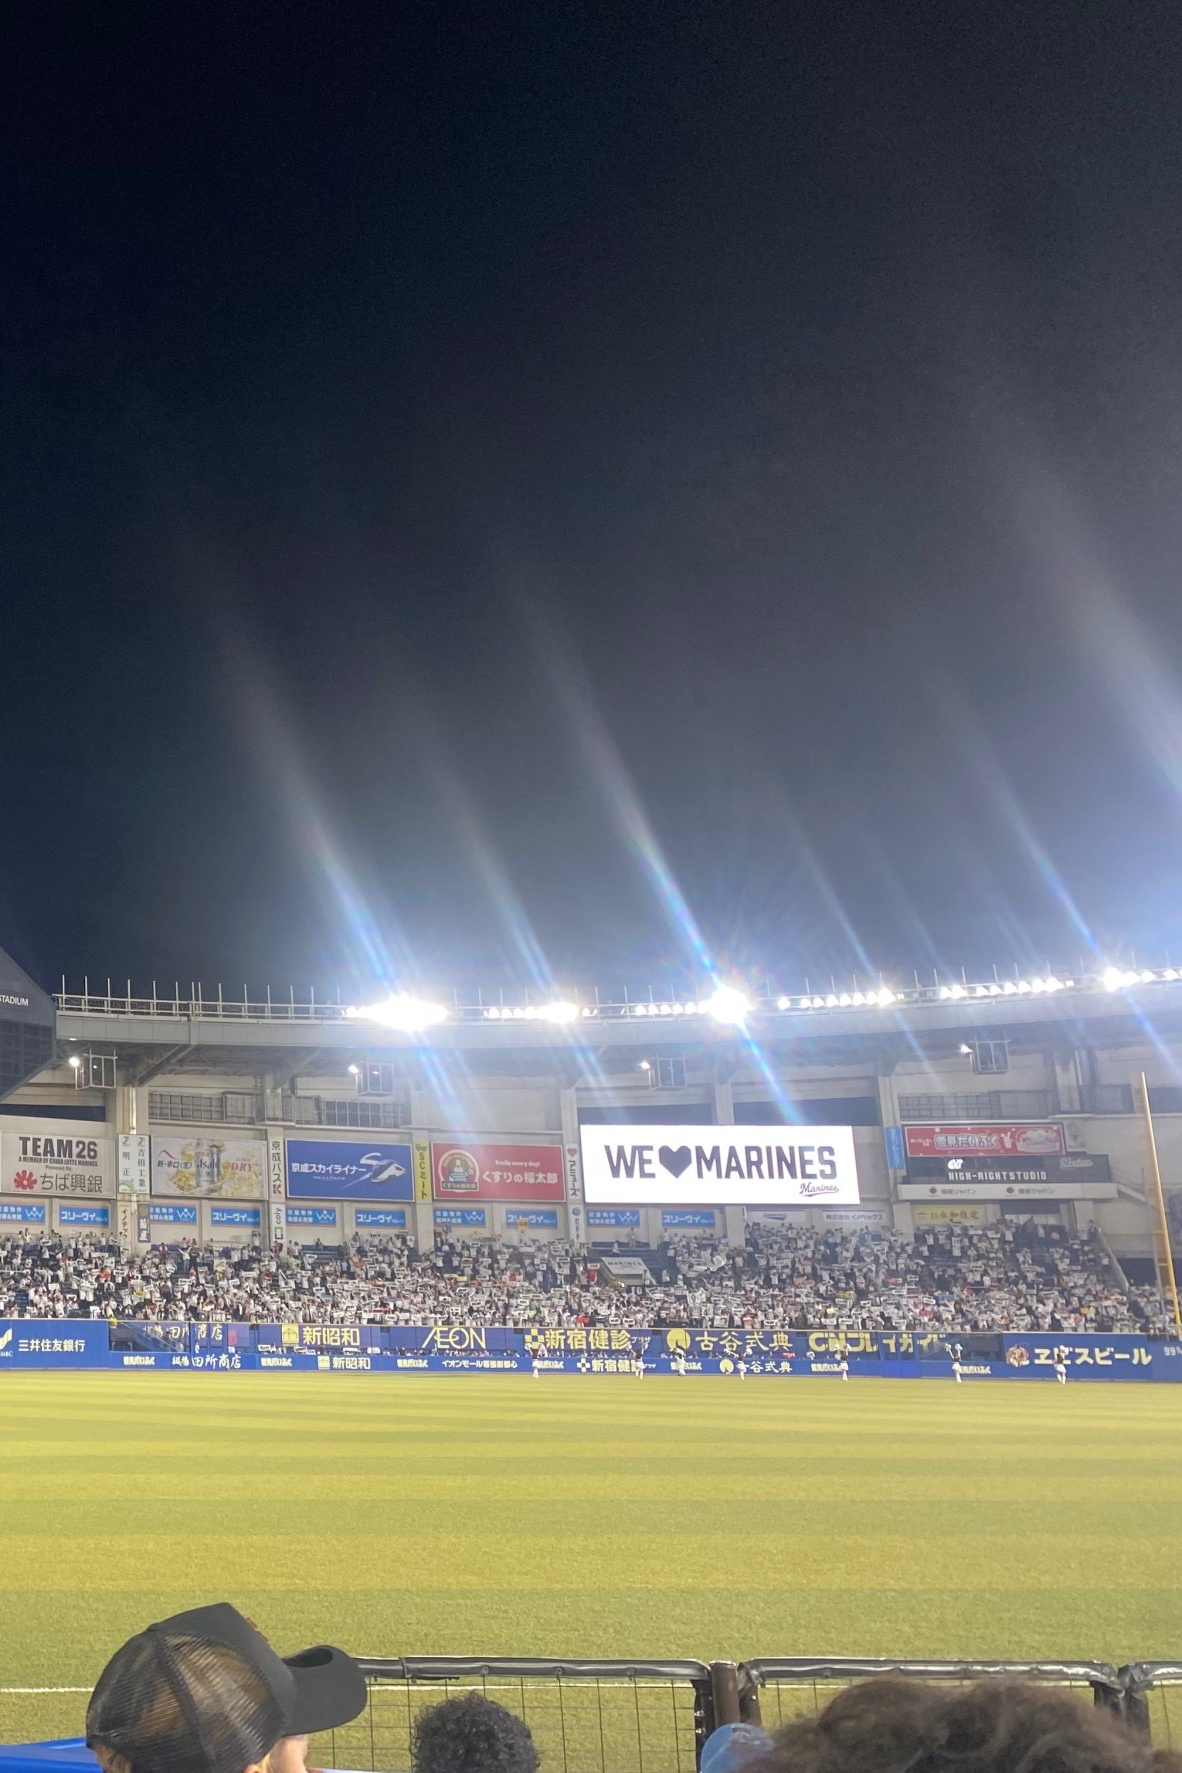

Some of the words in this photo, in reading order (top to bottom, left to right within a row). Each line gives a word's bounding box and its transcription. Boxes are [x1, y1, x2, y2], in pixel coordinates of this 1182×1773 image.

[19, 1136, 73, 1159] TEAM
[75, 1140, 98, 1159] 26
[272, 1141, 282, 1183] 京成バス
[291, 1162, 367, 1175] 京成スカイライナー
[604, 1145, 656, 1179] WE
[694, 1145, 838, 1179] MARINES
[40, 1173, 102, 1194] ちば興銀
[482, 1170, 558, 1184] くすりの福太郎
[799, 1182, 840, 1198] Marines
[302, 1326, 360, 1346] 新昭和
[695, 1330, 793, 1351] 古谷式典
[18, 1338, 86, 1353] 三井住友銀行
[191, 1354, 242, 1369] 田所商店
[332, 1356, 371, 1370] 新昭和
[736, 1361, 793, 1373] 谷式典
